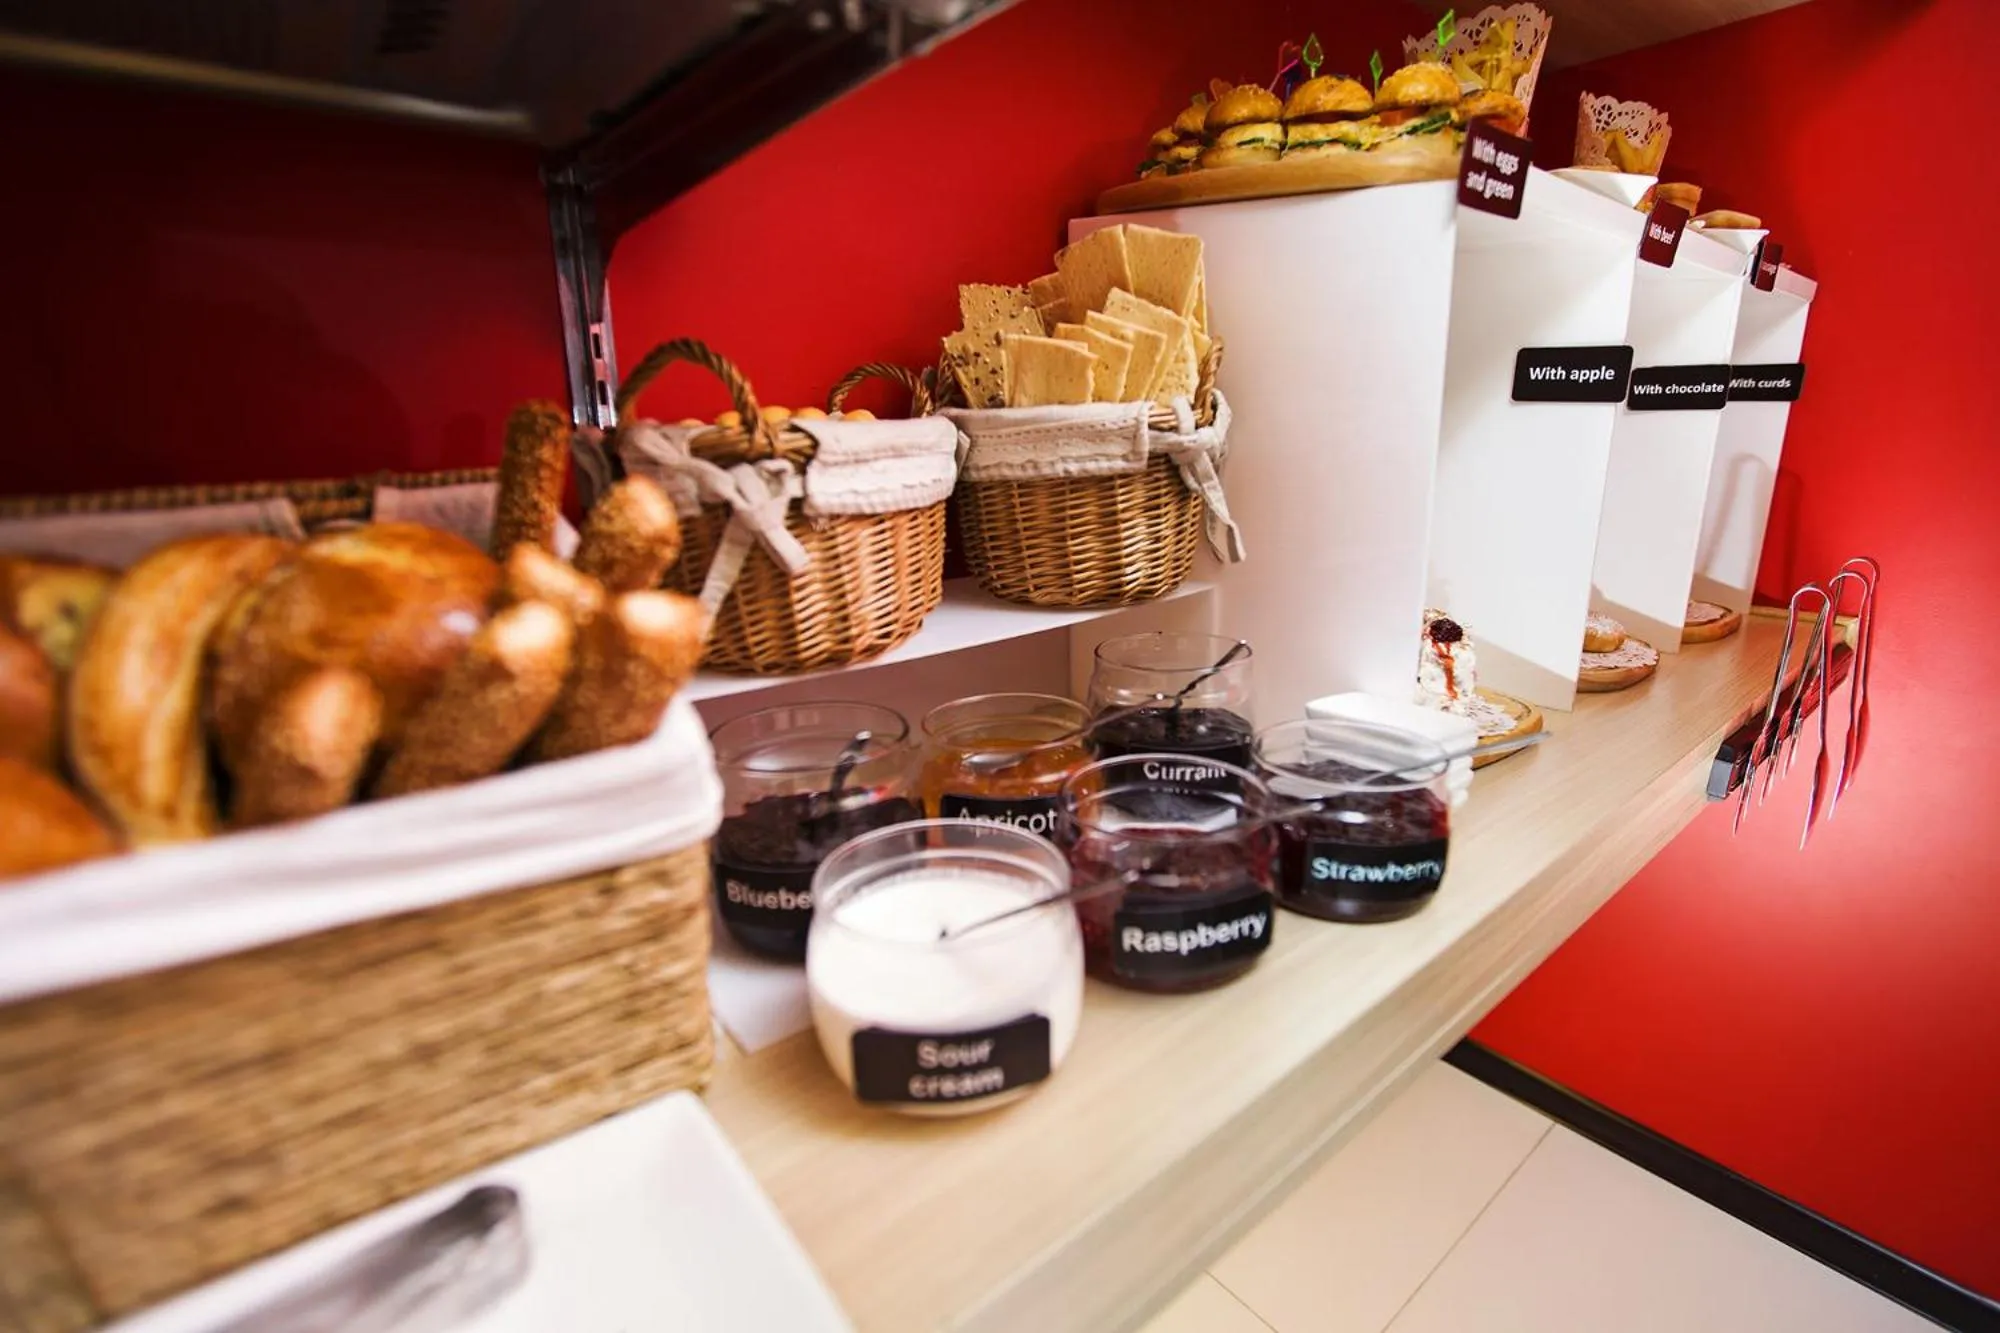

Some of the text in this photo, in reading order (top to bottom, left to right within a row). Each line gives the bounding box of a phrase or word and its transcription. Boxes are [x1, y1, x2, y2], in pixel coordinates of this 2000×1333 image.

[1472, 136, 1496, 166] With
[1466, 171, 1487, 192] and
[1529, 366, 1615, 383] With apple
[1758, 378, 1791, 388] curds
[1633, 382, 1724, 395] With chocolate
[1143, 761, 1228, 781] Currant
[726, 879, 813, 910] Bluebe
[1122, 912, 1267, 955] Raspberry
[917, 1038, 995, 1069] Sour
[908, 1066, 1005, 1098] cream
